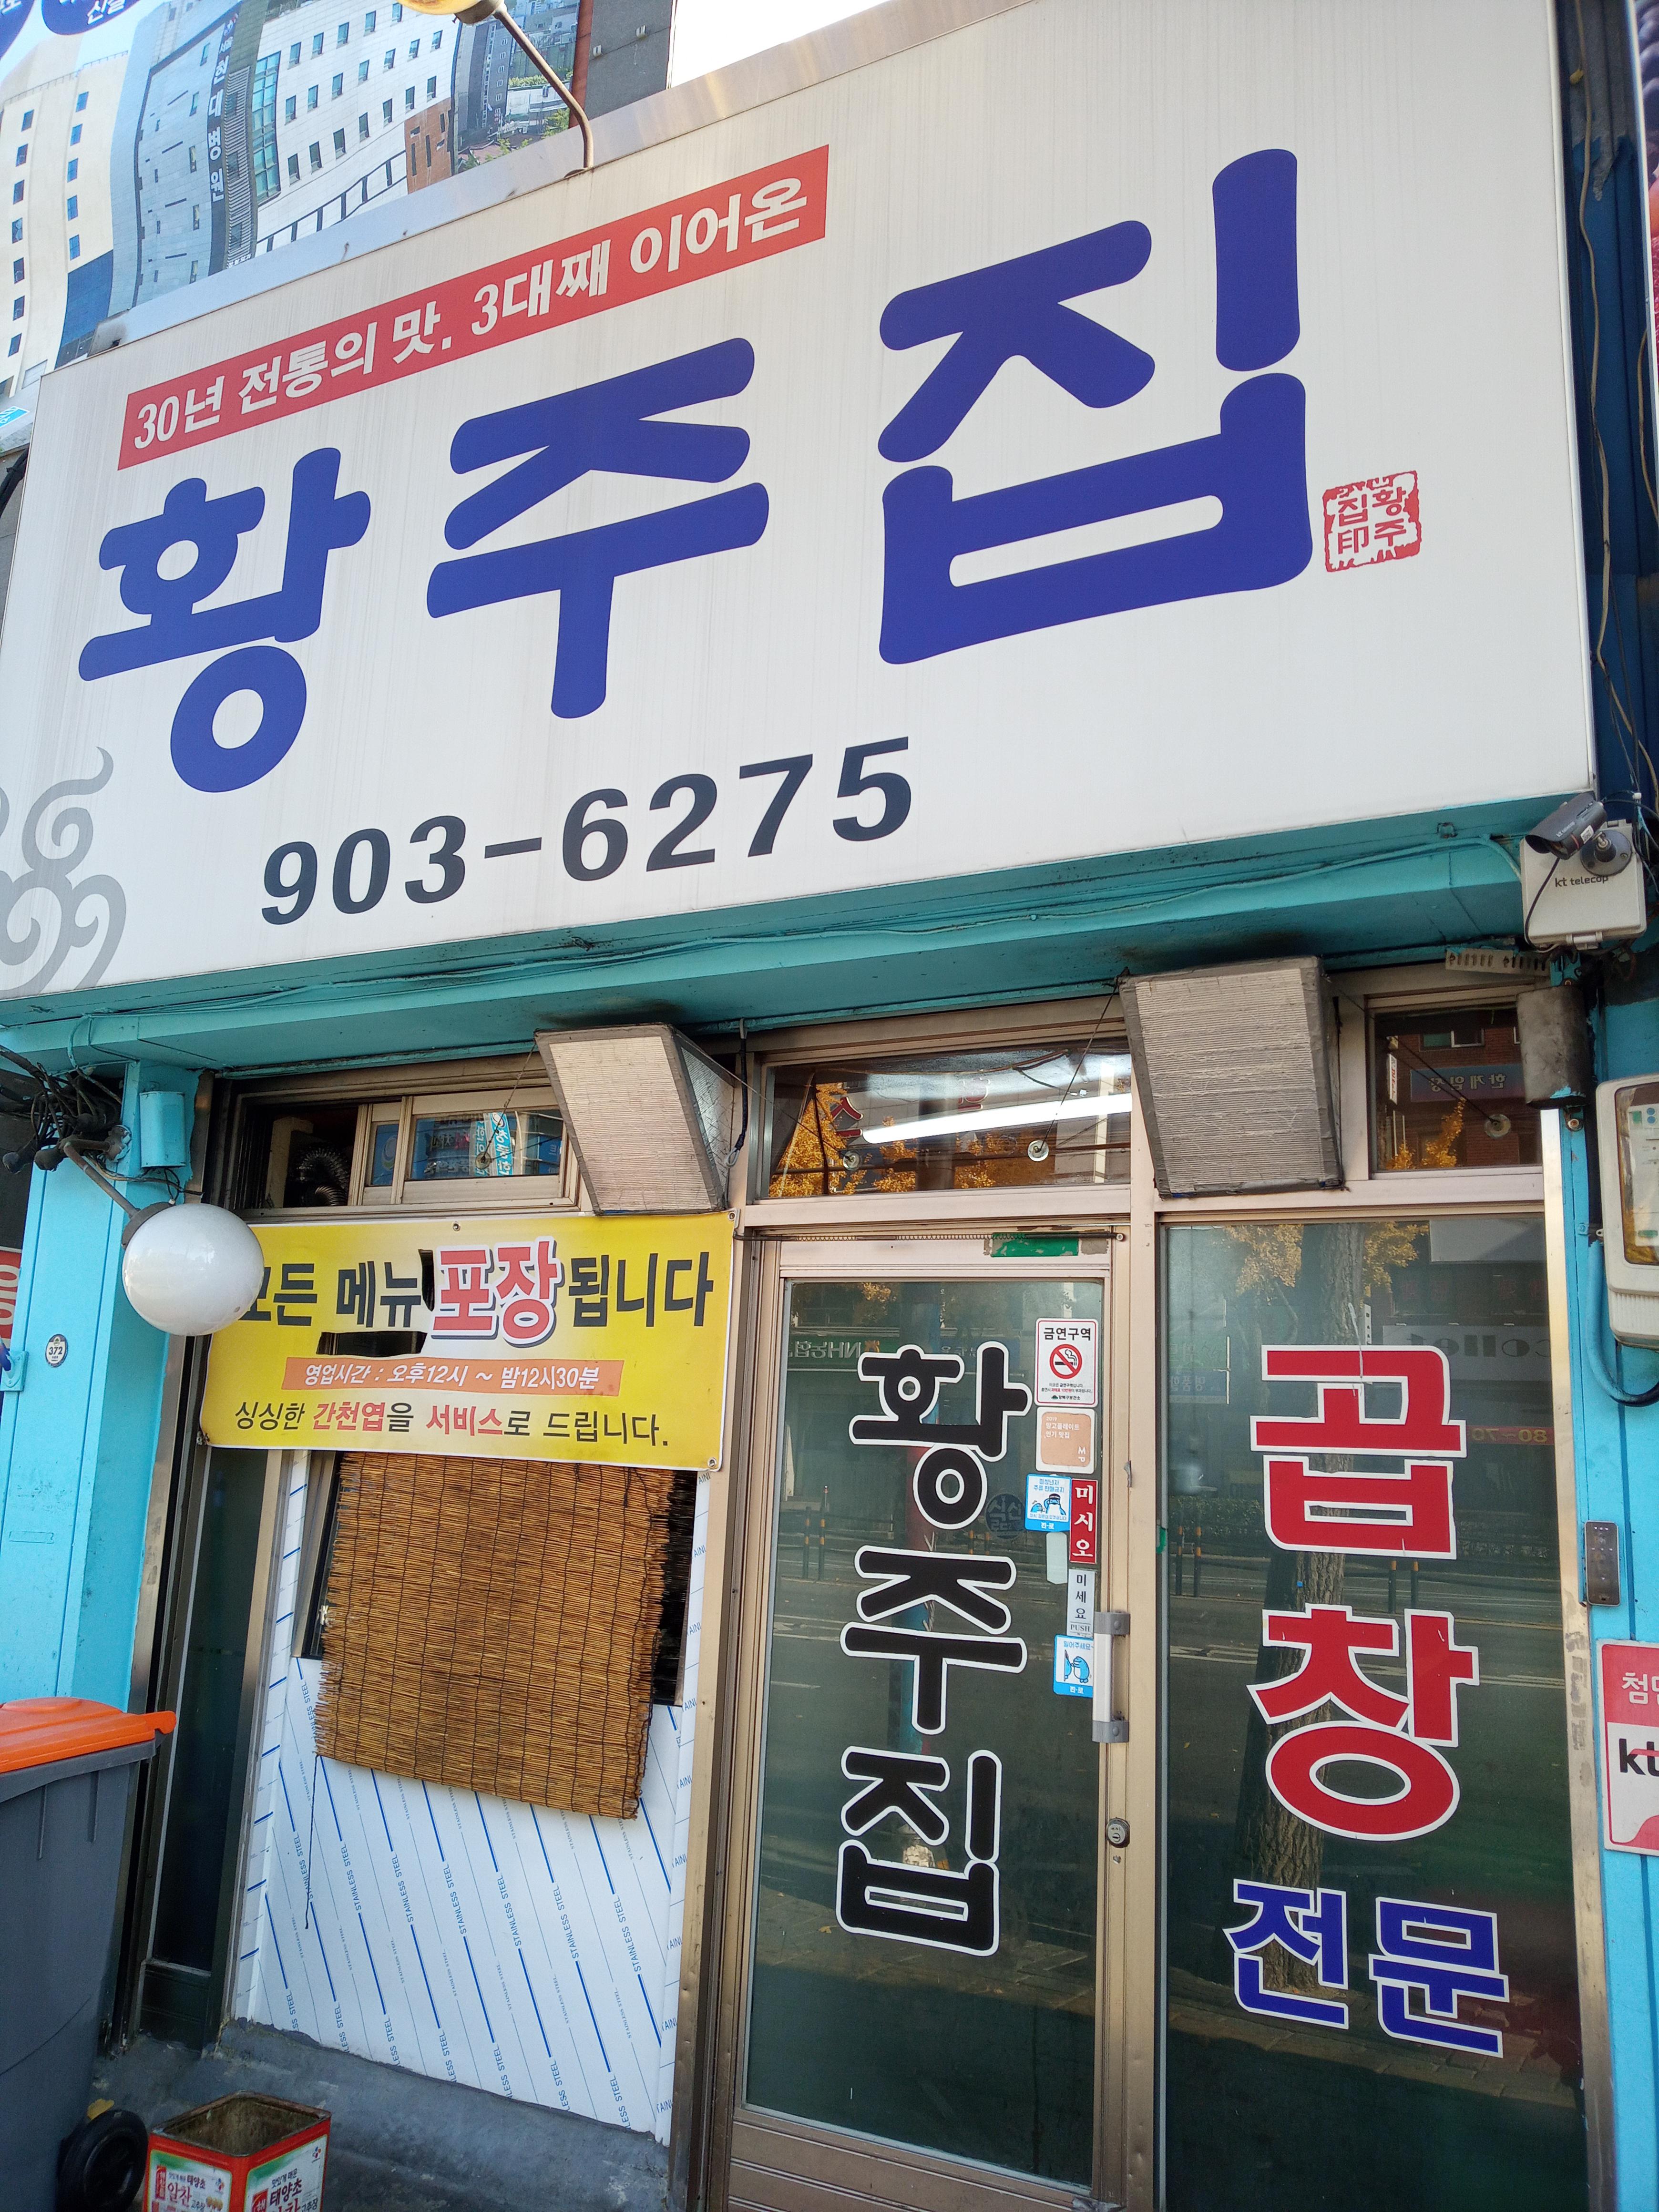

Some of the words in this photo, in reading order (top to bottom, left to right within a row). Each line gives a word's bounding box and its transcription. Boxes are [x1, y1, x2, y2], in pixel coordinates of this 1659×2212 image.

[134, 375, 225, 450] 30년
[238, 322, 378, 415] 전통의
[392, 301, 452, 364] 맛.
[471, 239, 611, 336] 3대째
[630, 178, 807, 273] 이어온
[79, 149, 1313, 794] 황주집
[1555, 878, 1567, 888] kt
[1570, 875, 1608, 886] telecop
[336, 1260, 421, 1328] 메뉴
[431, 1237, 564, 1343] 포장
[569, 1252, 715, 1328] 됩니다
[1044, 1327, 1091, 1341] 금연구역
[48, 1346, 63, 1355] 372
[304, 1364, 371, 1386] 영업시간
[386, 1362, 469, 1386] 오후12시
[501, 1365, 600, 1391] 밤12시30분
[235, 1402, 306, 1431] 싱싱한
[312, 1402, 415, 1434] 간천엽을
[426, 1404, 532, 1438] 서비스로
[543, 1410, 669, 1448] 드립니다.
[1045, 1422, 1080, 1430] 망고플레이트
[1072, 1485, 1094, 1557] 미시오
[1075, 1574, 1087, 1620] 미세요
[1246, 1344, 1480, 1842] 곱창
[1070, 1624, 1091, 1632] PUSH
[836, 1341, 1033, 1957] 황주집
[301, 1681, 311, 1704] STEEL
[302, 1774, 311, 1801] STAINLESS
[350, 1784, 360, 1811] STAINLESS
[399, 1792, 410, 1820] STAINLESS
[451, 1802, 462, 1829] STAINLESS
[504, 1812, 516, 1840] STAINLESS
[563, 1821, 575, 1850] STAINLESS
[293, 1833, 304, 1857] STEEL
[340, 1843, 351, 1867] STEEL
[622, 1831, 634, 1860] STAINLESS
[391, 1853, 402, 1878] STEEL
[443, 1864, 454, 1889] STEEL
[347, 1869, 362, 1911] STAINLESS
[497, 1873, 509, 1900] STEEL
[553, 1884, 565, 1911] STEEL
[398, 1880, 414, 1923] STAINLESS
[450, 1891, 467, 1935] STAINLESS
[613, 1895, 626, 1924] STEEL
[504, 1902, 522, 1947] STAINLESS
[560, 1914, 579, 1959] STAINLESS
[295, 1931, 304, 1958] STAINLESS
[343, 1943, 352, 1971] STAINLESS
[622, 1926, 642, 1972] STAINLESS
[395, 1955, 405, 1984] STAINLESS
[447, 1967, 457, 1997] STAINLESS
[1222, 1878, 1510, 2058] 전문
[286, 1990, 296, 2015] STEEL
[501, 1980, 512, 2010] STAINLESS
[558, 1994, 569, 2024] STAINLESS
[334, 2003, 344, 2029] STEEL
[384, 2017, 395, 2043] STEEL
[620, 2007, 632, 2039] STAINLESS
[439, 2029, 450, 2057] STEEL
[493, 2044, 505, 2072] STEEL
[550, 2059, 563, 2087] STEEL
[609, 2074, 623, 2102] STEEL
[269, 2178, 302, 2206] 태양초
